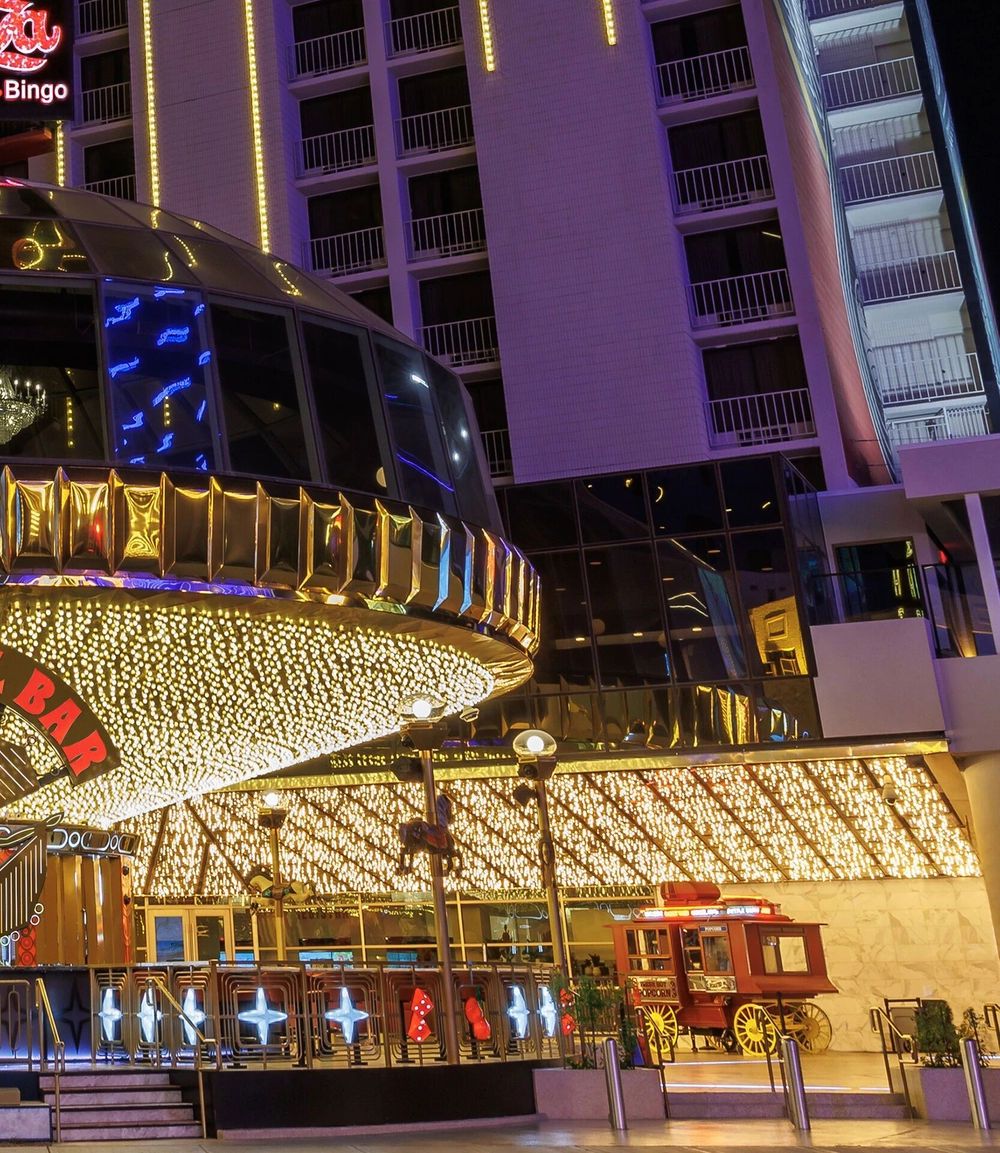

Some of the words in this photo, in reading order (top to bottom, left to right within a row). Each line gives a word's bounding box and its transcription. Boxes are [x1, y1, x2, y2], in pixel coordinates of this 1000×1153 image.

[4, 80, 68, 103] Bingo
[13, 668, 107, 776] BAR
[639, 988, 671, 998] POPCORN
